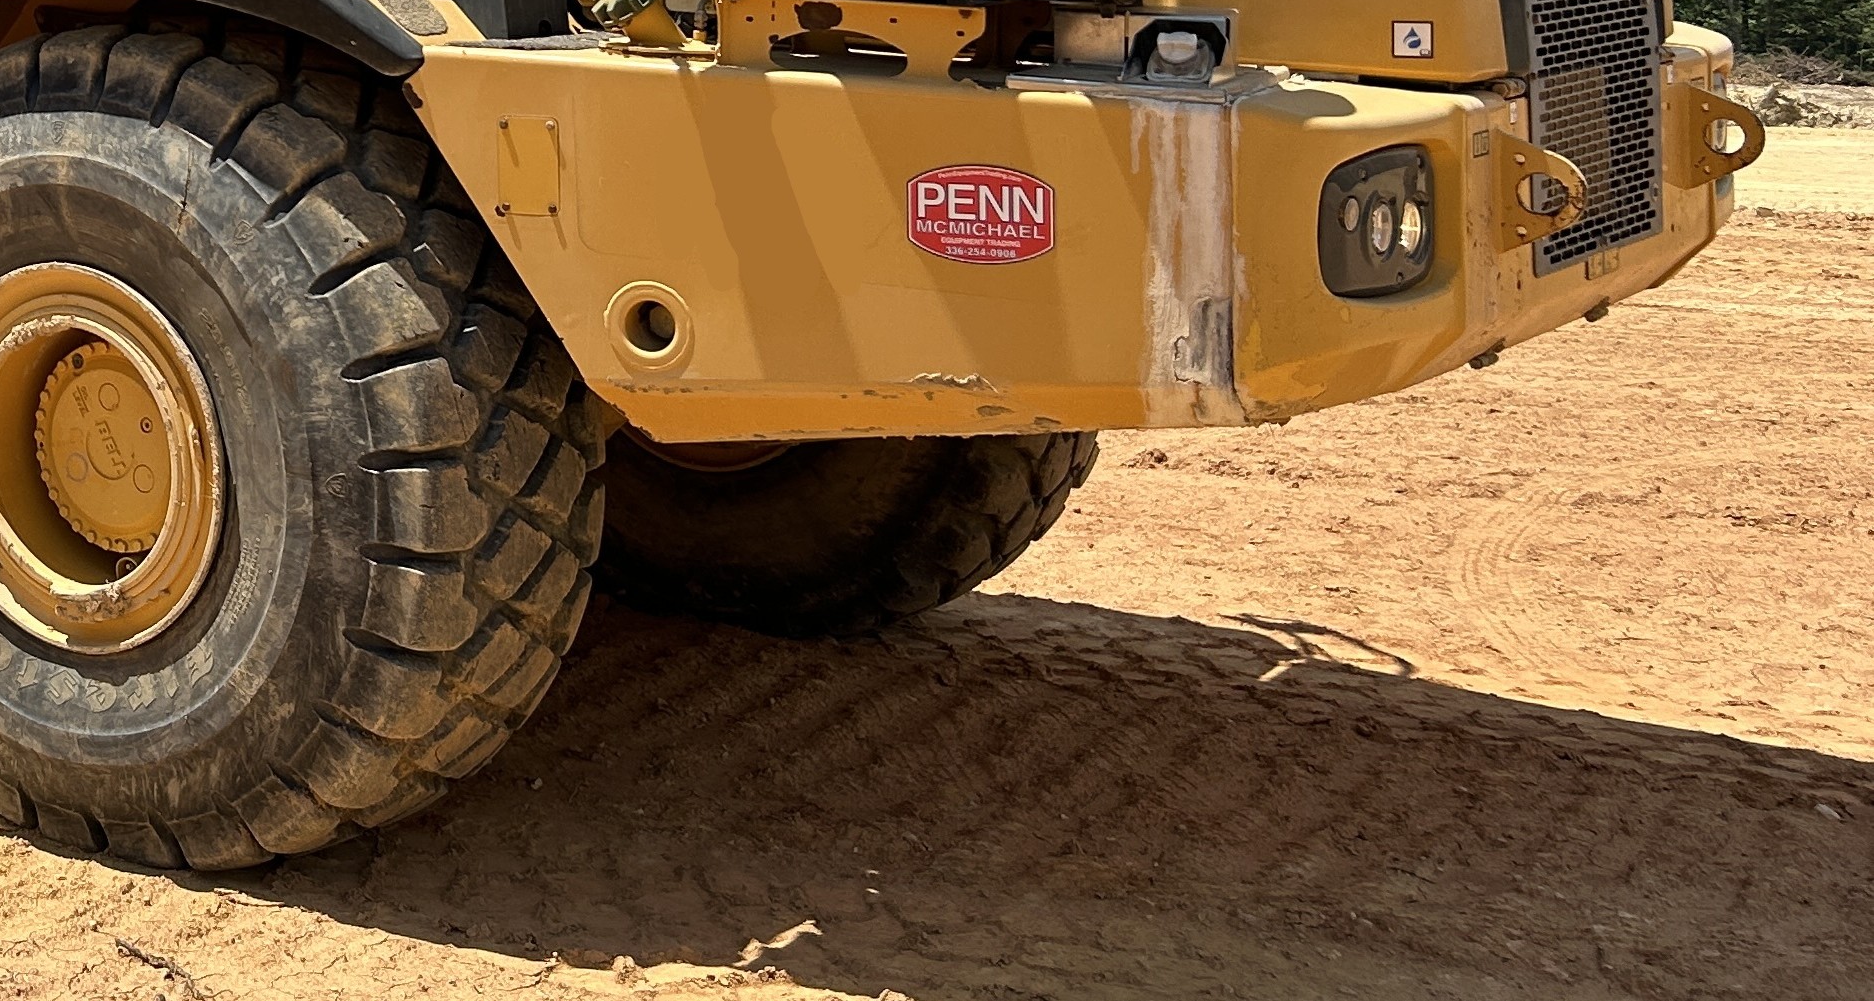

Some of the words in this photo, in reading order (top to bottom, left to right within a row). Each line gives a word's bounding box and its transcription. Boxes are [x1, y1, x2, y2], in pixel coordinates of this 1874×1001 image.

[916, 181, 1044, 224] PENN
[915, 219, 1046, 240] MCMICHAEL
[986, 239, 1022, 248] TRADING
